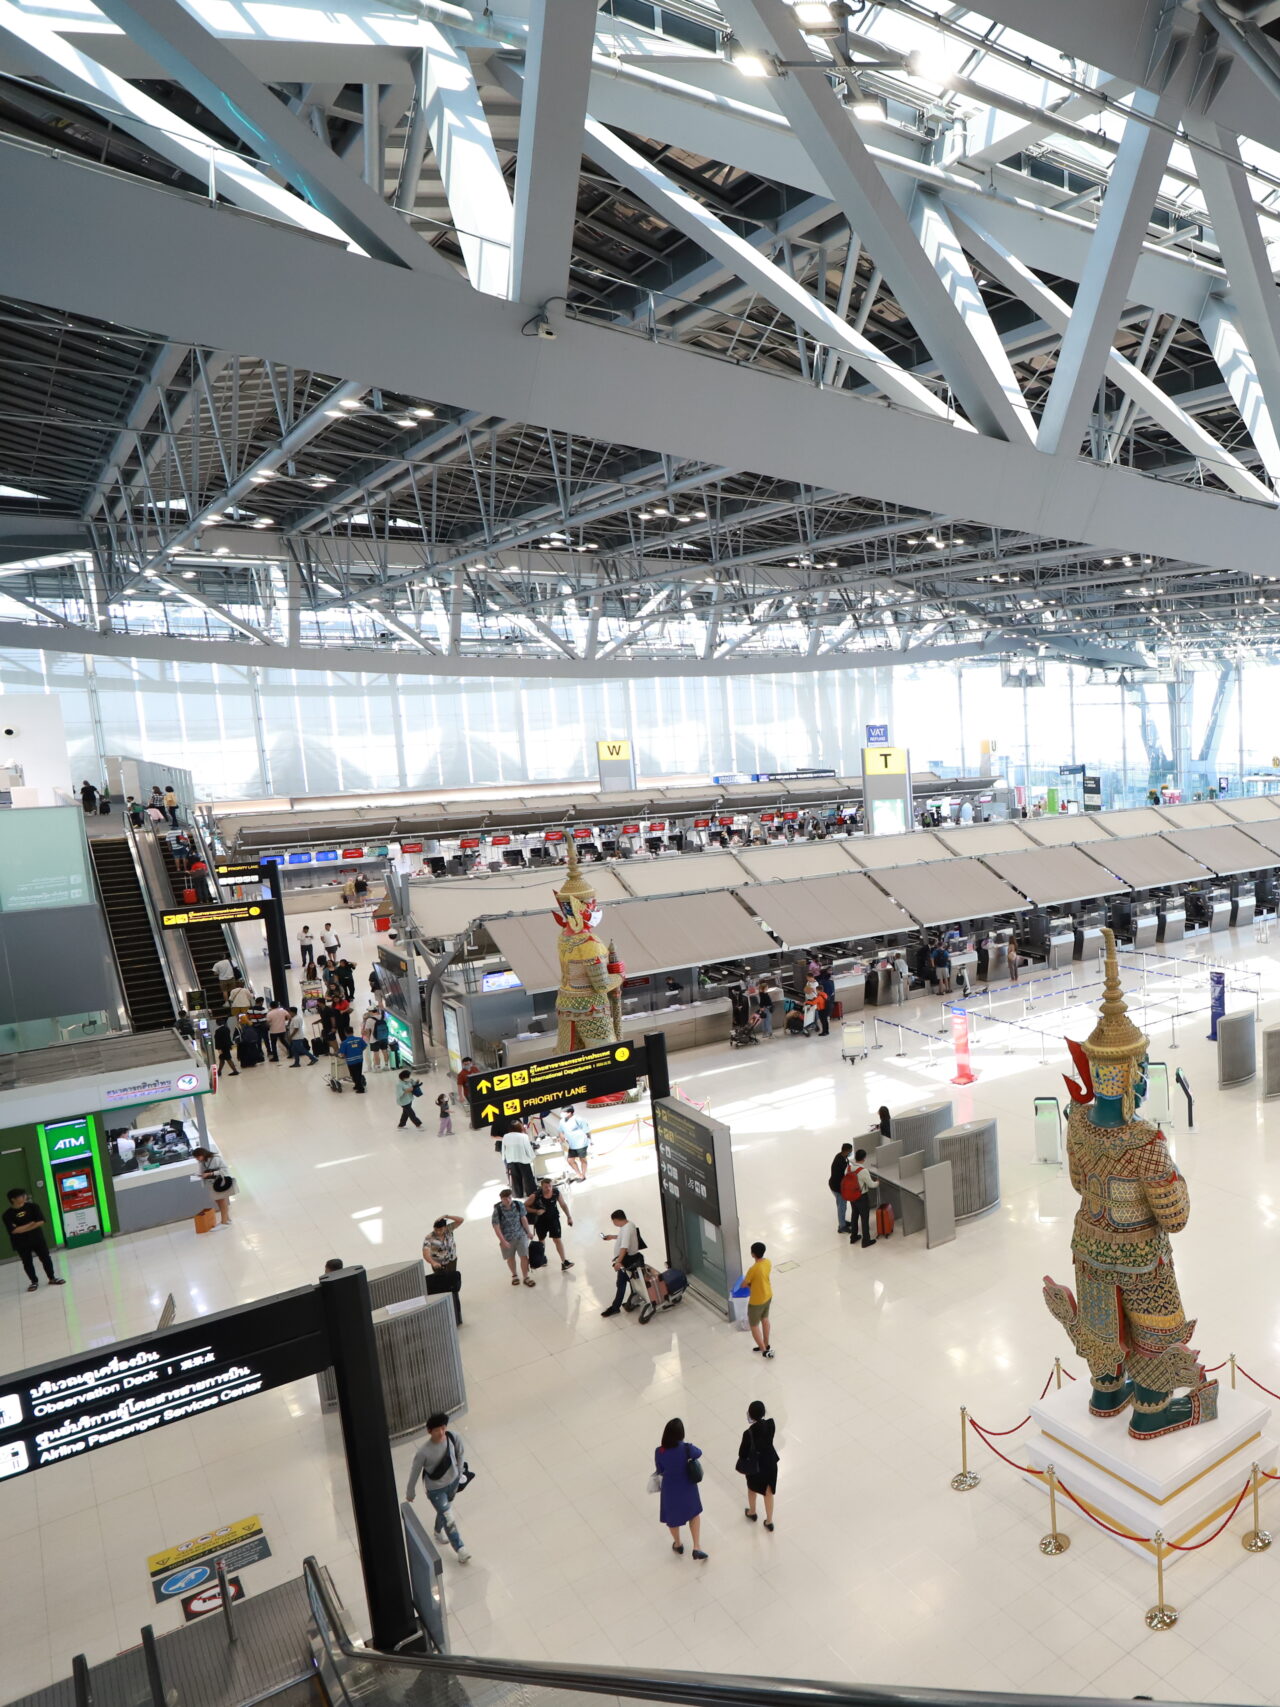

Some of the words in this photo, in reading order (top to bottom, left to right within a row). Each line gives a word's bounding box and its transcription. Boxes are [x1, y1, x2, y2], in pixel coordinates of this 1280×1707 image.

[870, 728, 884, 736] VAT
[607, 745, 621, 756] W
[879, 753, 892, 769] T
[530, 1070, 563, 1083] International
[564, 1065, 592, 1075] Departures
[523, 1091, 564, 1107] PRIORITY
[565, 1085, 588, 1097] LANE
[54, 1135, 85, 1150] ATM
[33, 1383, 120, 1417] Observation
[123, 1369, 159, 1390] Deck
[39, 1440, 86, 1464] Airline
[88, 1415, 161, 1448] Passenger
[163, 1395, 219, 1421] Services
[221, 1380, 263, 1401] Center
